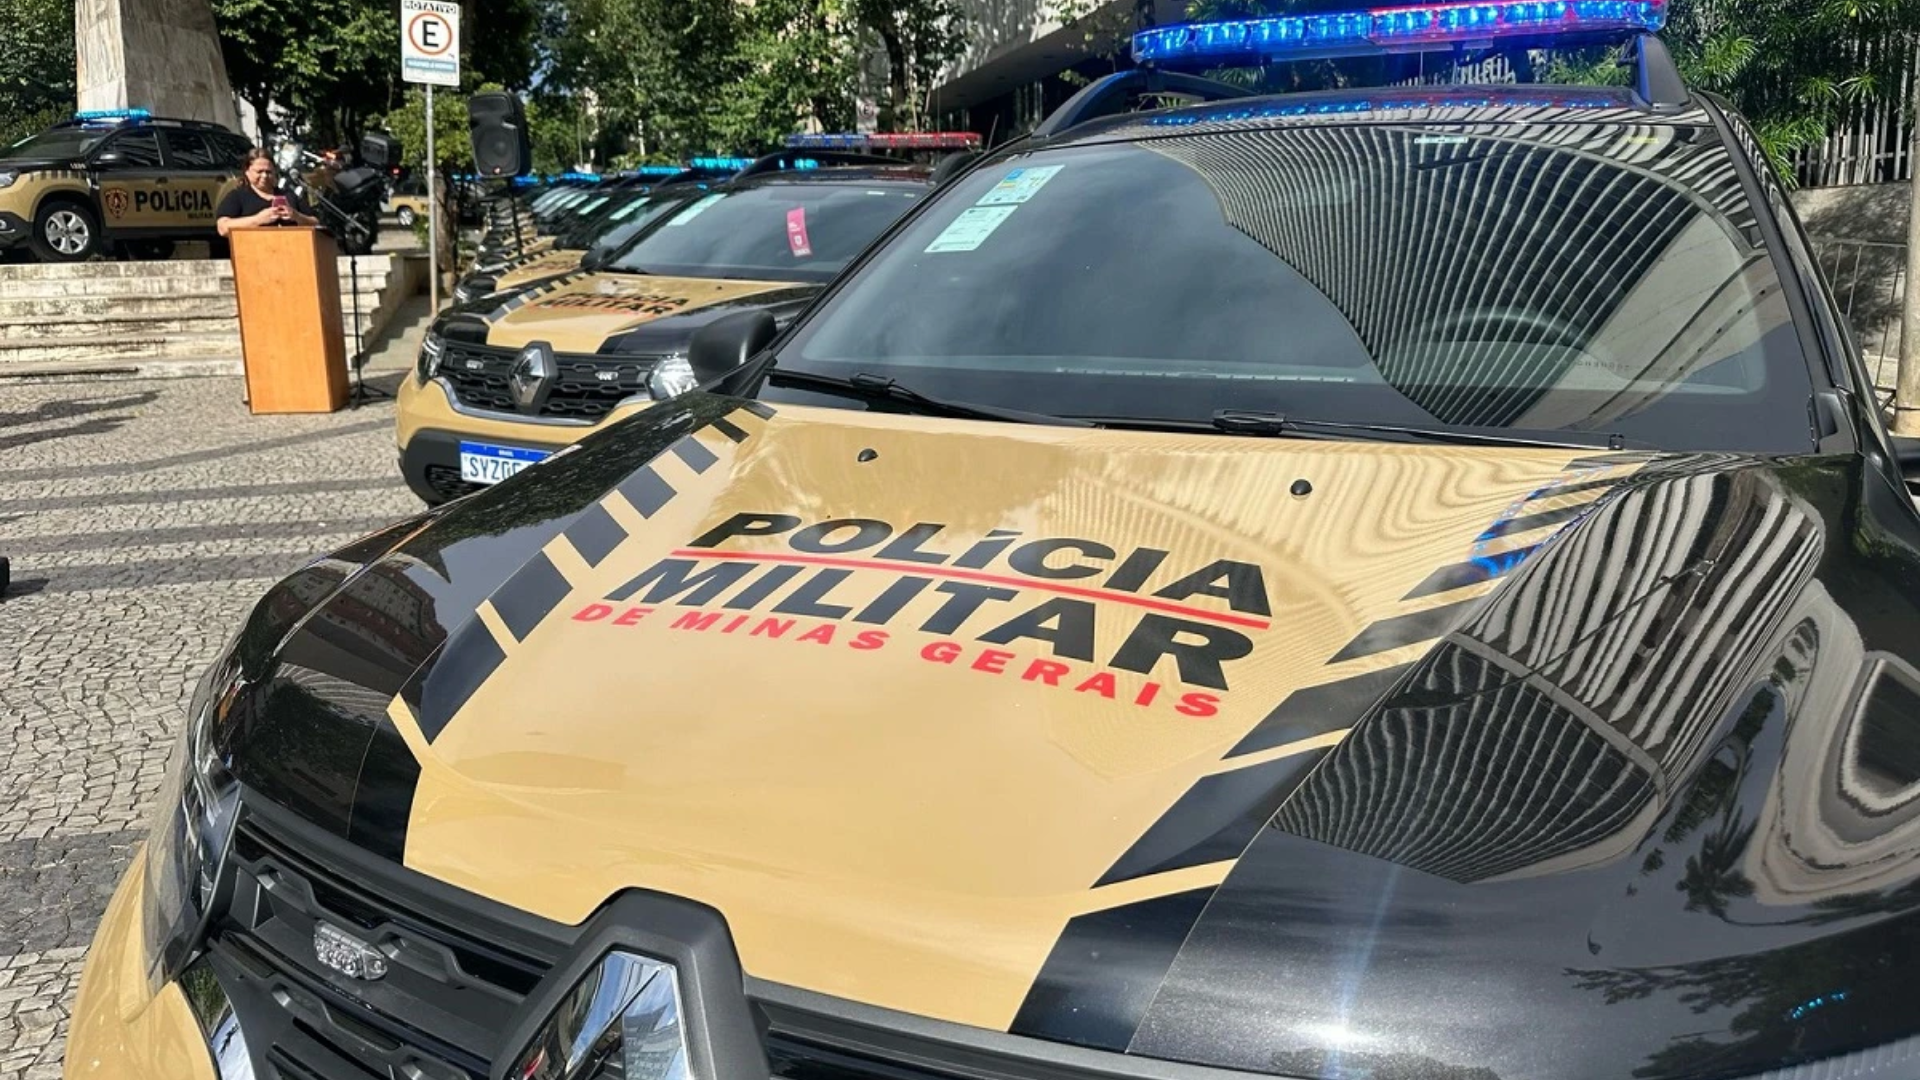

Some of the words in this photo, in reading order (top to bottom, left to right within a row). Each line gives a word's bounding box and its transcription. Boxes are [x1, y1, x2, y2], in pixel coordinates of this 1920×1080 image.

[422, 20, 439, 47] E
[571, 603, 654, 625] DE
[669, 611, 891, 650] MINAS
[920, 641, 1221, 717] GERAIS
[602, 558, 1254, 691] MILITAR
